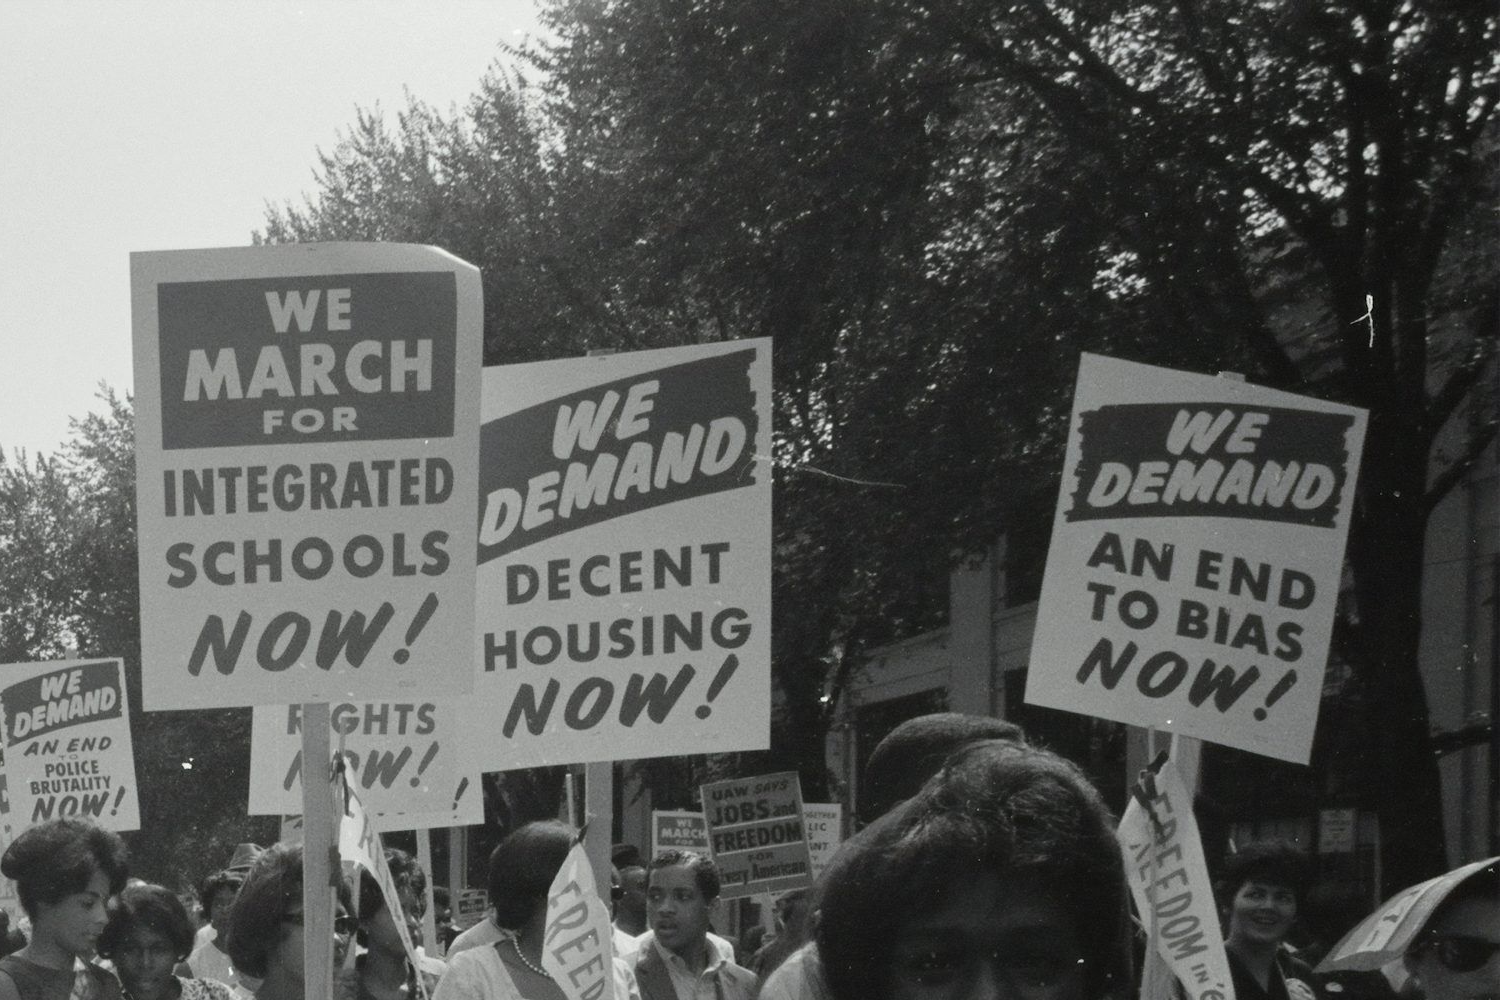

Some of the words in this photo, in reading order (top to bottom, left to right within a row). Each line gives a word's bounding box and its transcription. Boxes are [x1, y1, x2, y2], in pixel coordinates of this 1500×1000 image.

[265, 288, 352, 333] WE
[183, 338, 433, 402] MARCH
[263, 406, 359, 435] FOR
[552, 380, 660, 460] WE
[1166, 408, 1270, 456] WE
[163, 457, 454, 518] INTEGRATED
[479, 416, 748, 547] DEMAND
[1087, 458, 1335, 510] DEMAND
[165, 530, 451, 590] SCHOOLS
[506, 541, 731, 605] DECENT
[1086, 531, 1176, 583] AN
[1194, 549, 1316, 611] END
[187, 591, 440, 678] NOW!
[483, 607, 753, 673] HOUSING
[1086, 581, 1159, 631] TO
[1175, 598, 1304, 663] BIAS
[41, 669, 83, 701] WE
[503, 653, 740, 739] NOW!
[1076, 637, 1298, 722] NOW!
[13, 686, 116, 737] DEMAND
[287, 703, 436, 736] RGHTS
[24, 739, 59, 757] AN
[66, 736, 112, 753] END
[45, 760, 99, 778] POLICE
[30, 775, 111, 796] BRUTALITY
[31, 785, 126, 823] NOW!
[712, 786, 749, 801] UAW
[753, 780, 789, 794] SAYS
[661, 828, 707, 839] MARCH
[711, 800, 769, 826] JOBS
[773, 800, 797, 817] and
[713, 821, 801, 854] FREEDOM
[748, 852, 774, 862] FOR
[1191, 963, 1210, 984] IN
